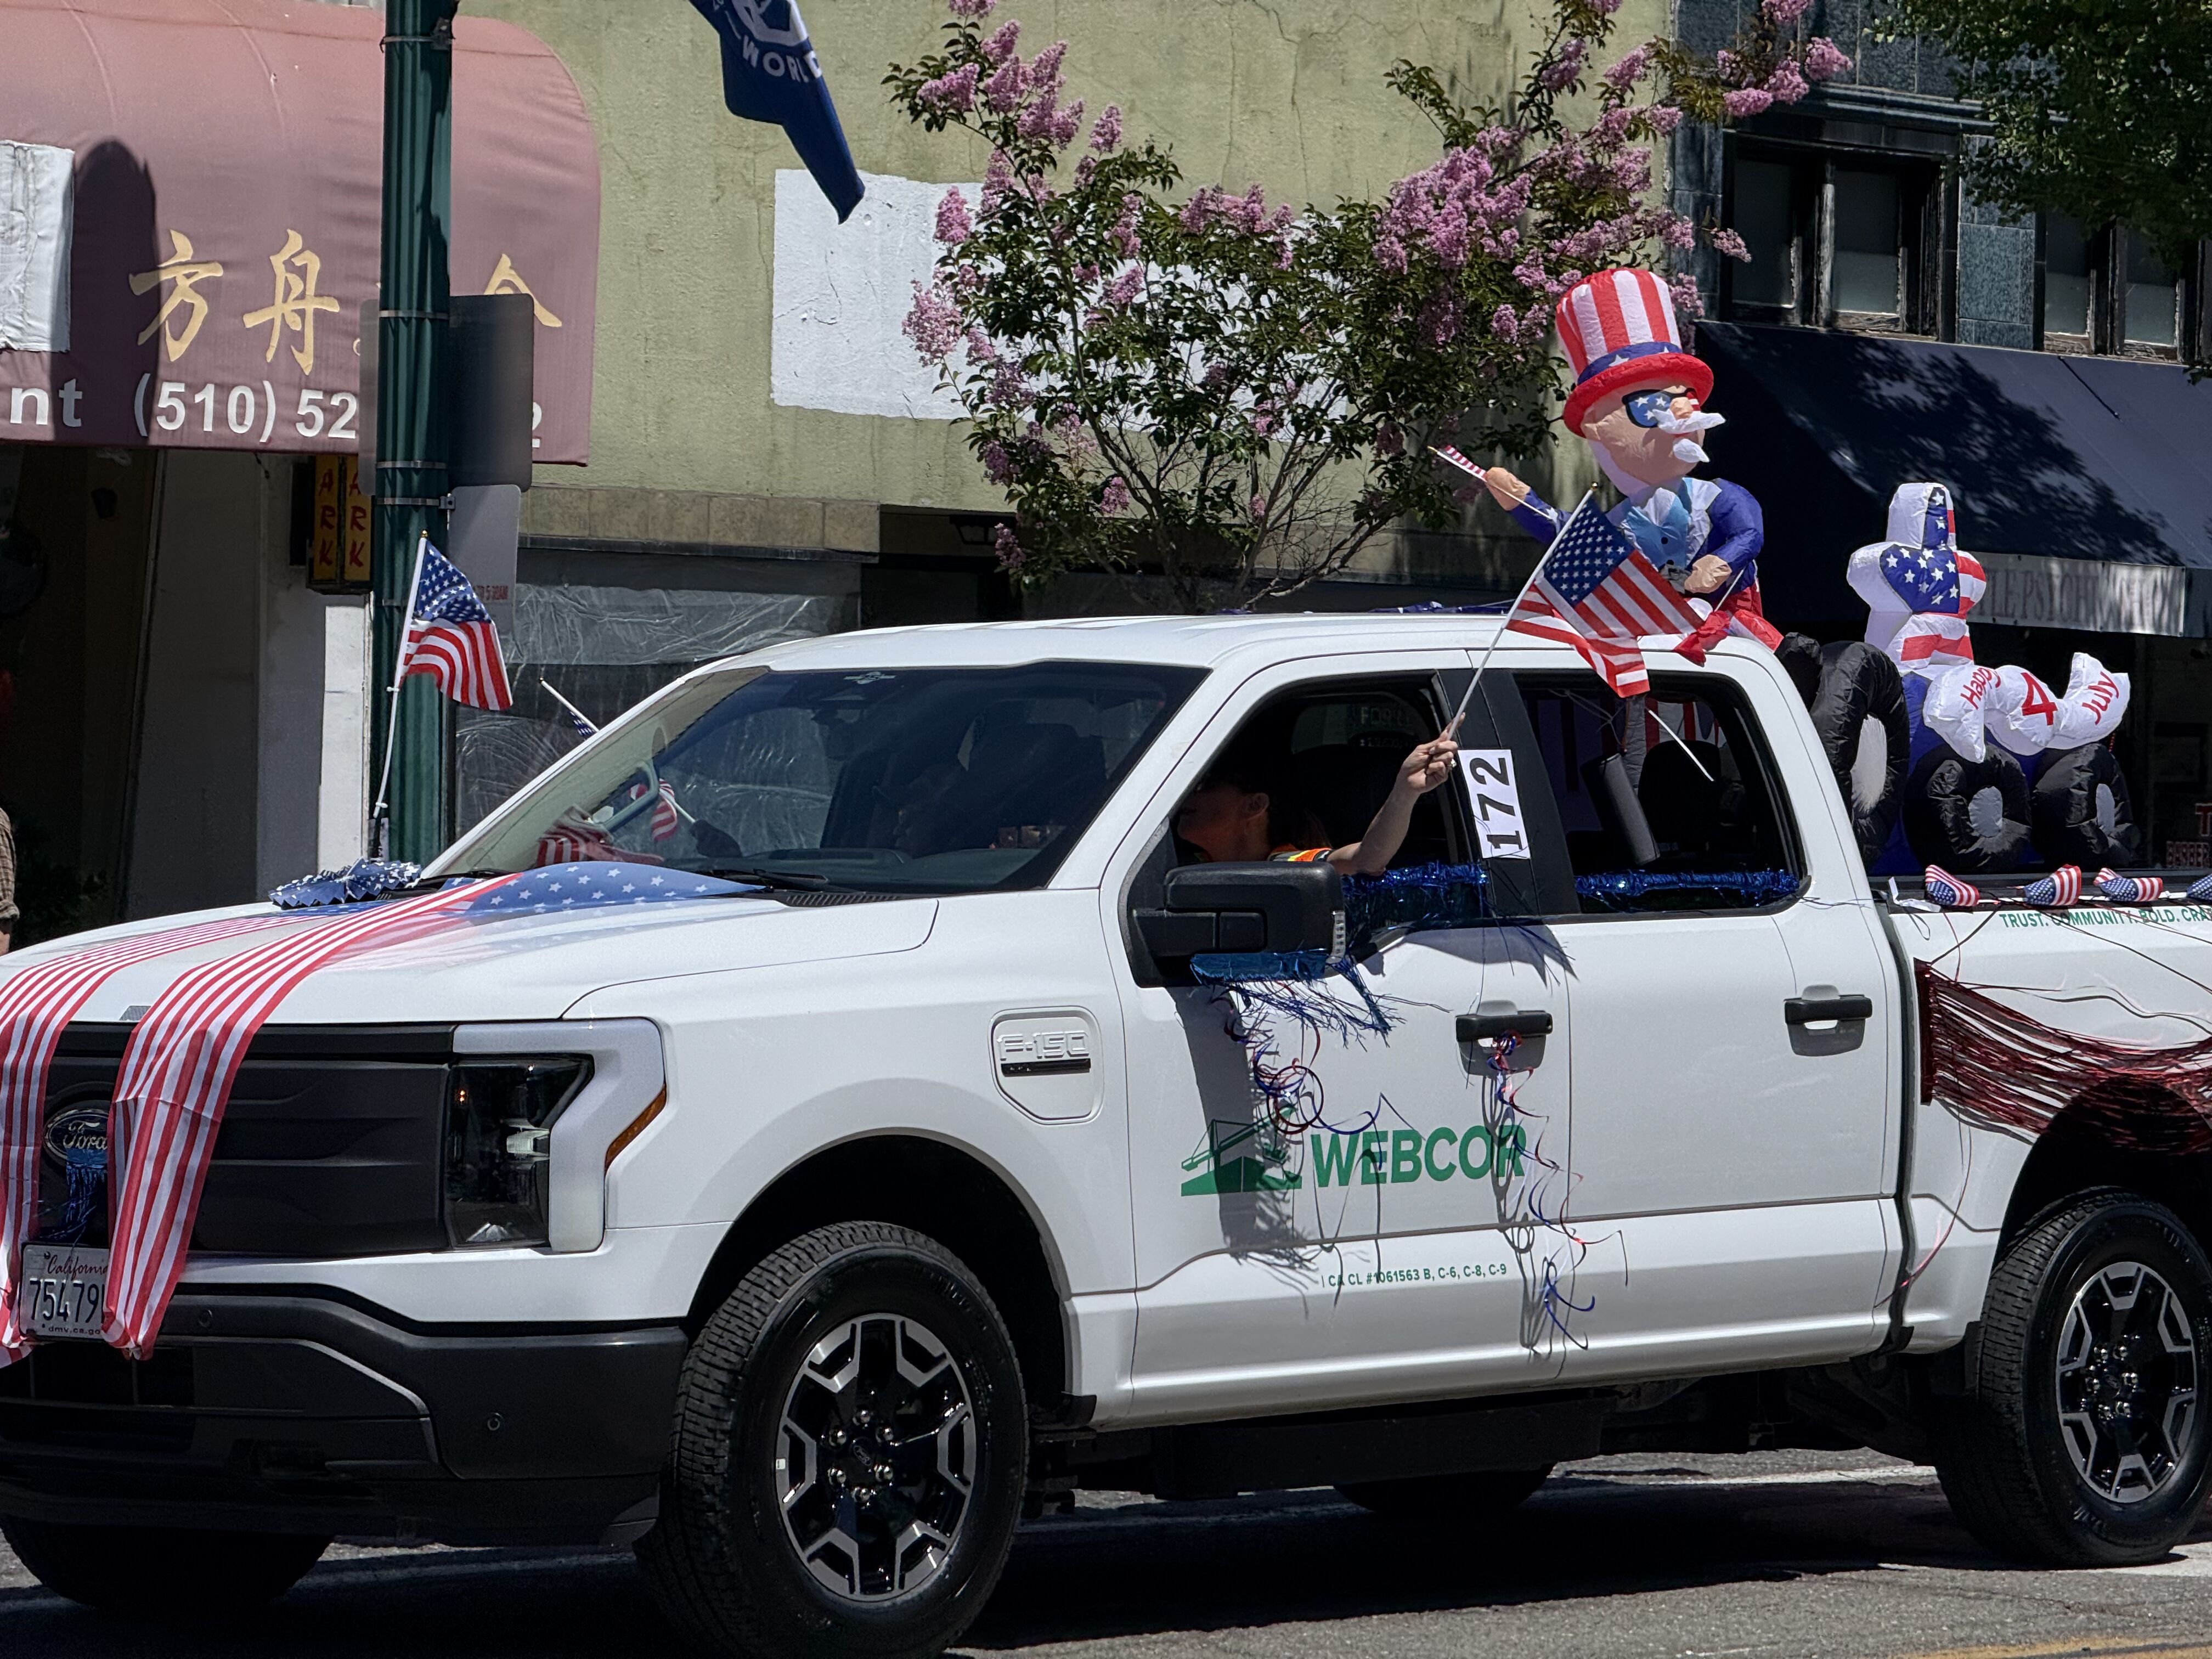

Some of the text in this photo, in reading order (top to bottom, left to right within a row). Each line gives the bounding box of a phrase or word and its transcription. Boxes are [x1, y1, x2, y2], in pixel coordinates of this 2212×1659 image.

[742, 35, 822, 82] WORLD
[134, 372, 276, 444] (510)
[318, 468, 337, 566] ARK
[1960, 667, 2119, 726] Happy 4 July
[1469, 757, 1523, 850] 172
[1999, 913, 2049, 928] TRUST.
[2140, 909, 2181, 923] BOLD.
[996, 1030, 1090, 1062] F-150
[1311, 1124, 1525, 1188] WEBCOR
[29, 1279, 105, 1324] 75479
[1328, 1263, 1508, 1288] CA CL #1061563 B, C-6, C-8, C-9
